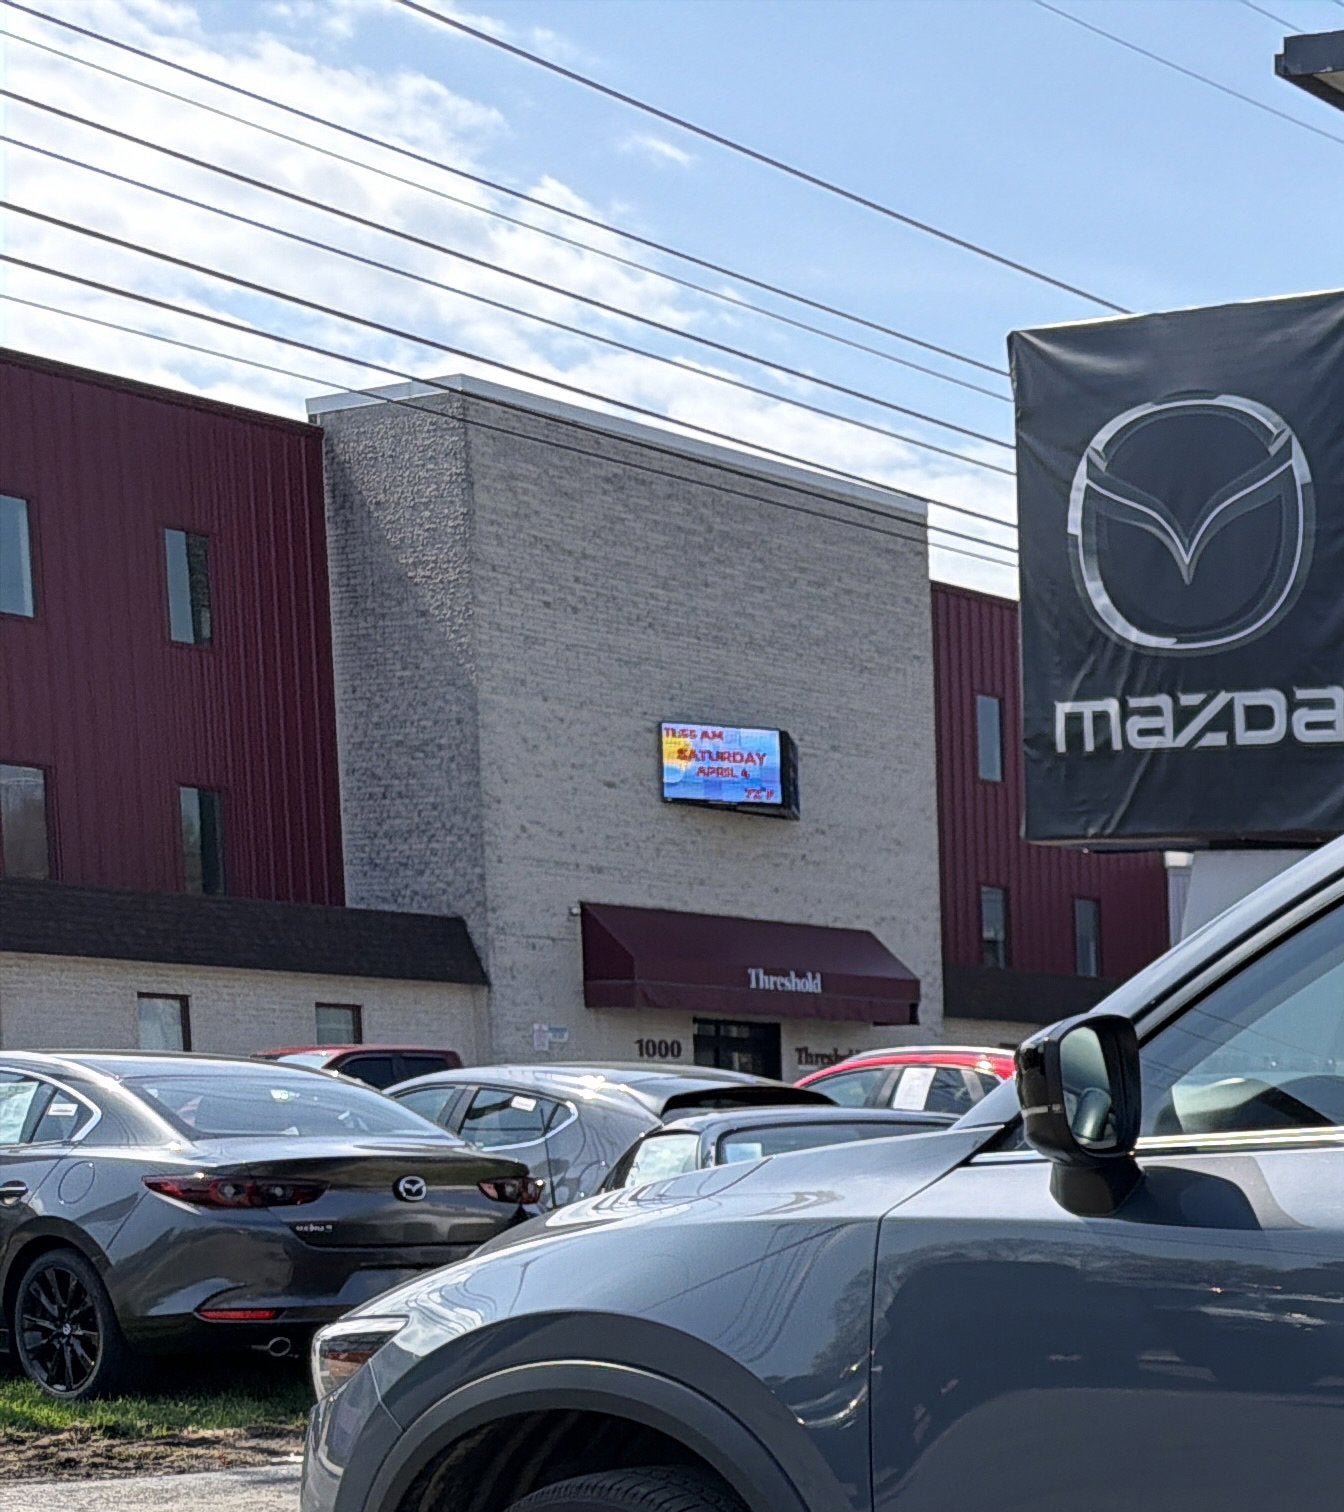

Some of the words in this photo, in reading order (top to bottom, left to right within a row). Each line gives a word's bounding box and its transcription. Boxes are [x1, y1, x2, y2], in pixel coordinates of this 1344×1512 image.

[700, 730, 724, 741] AM
[677, 748, 767, 766] SATURDAY
[697, 766, 738, 778] APRIL
[741, 768, 751, 779] 4
[747, 968, 822, 994] Threshold
[634, 1038, 682, 1059] 1000
